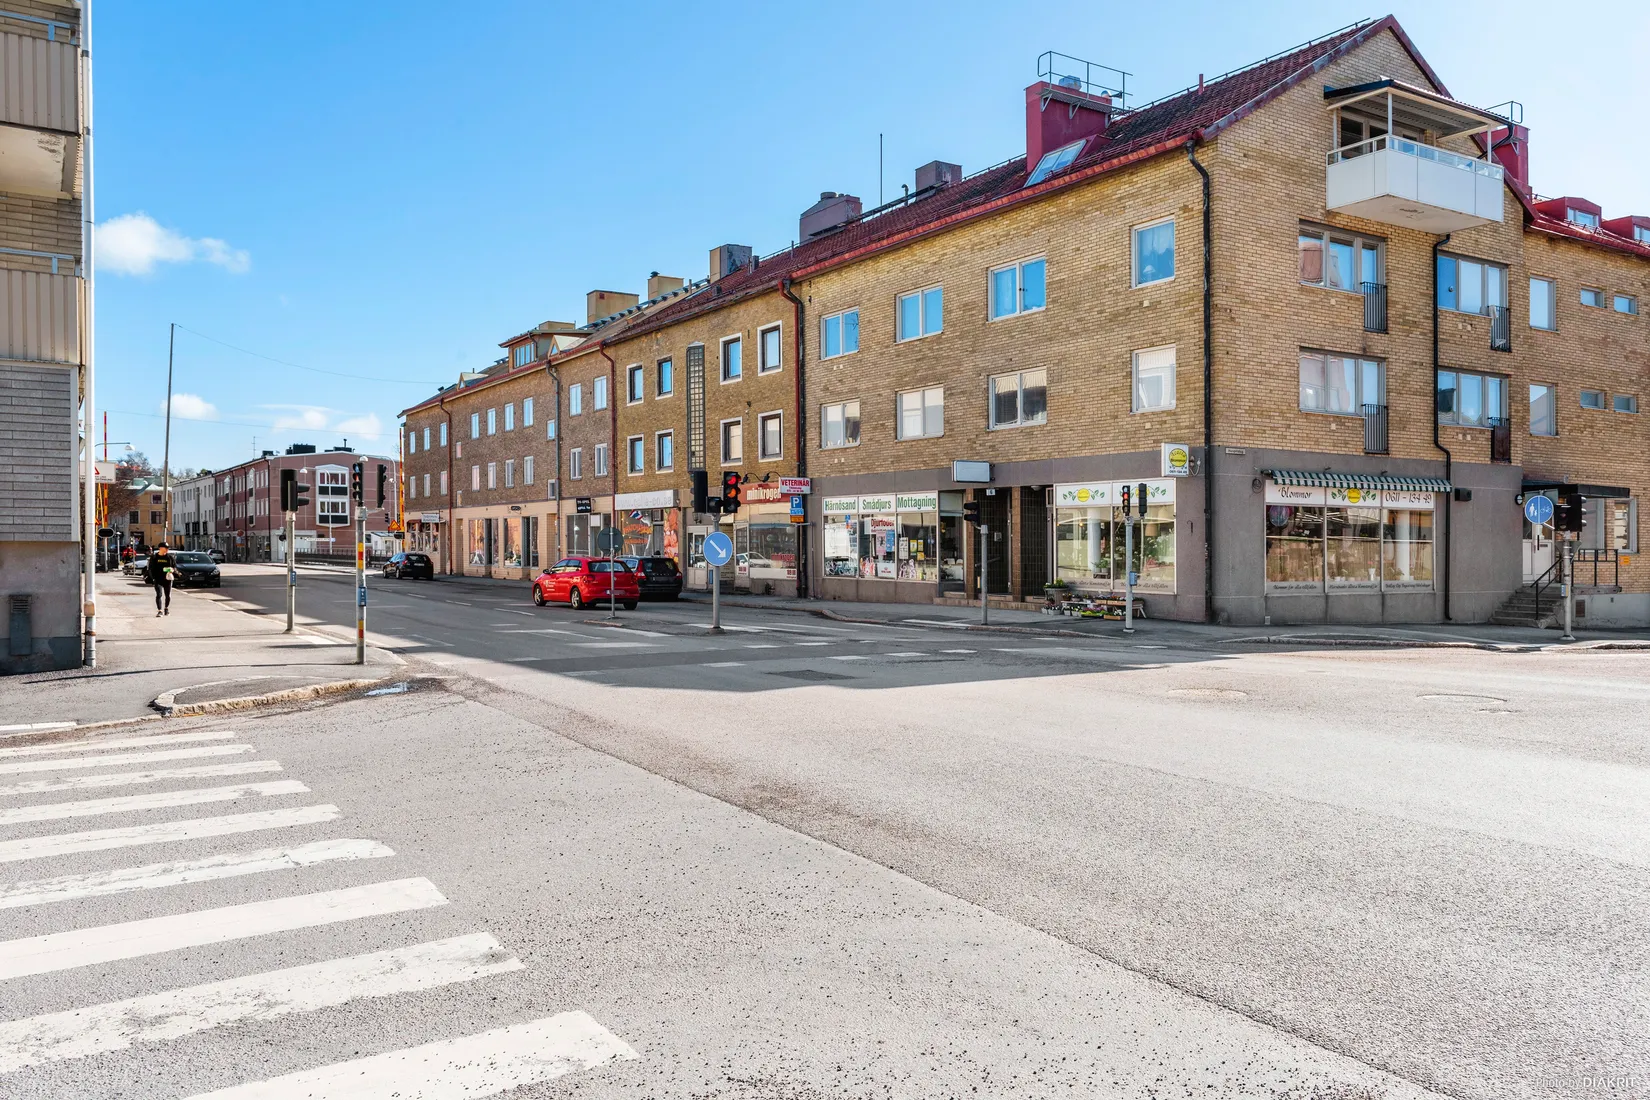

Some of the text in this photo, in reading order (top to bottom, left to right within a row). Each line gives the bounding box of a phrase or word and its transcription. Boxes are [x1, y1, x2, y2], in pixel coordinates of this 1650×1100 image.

[781, 478, 810, 487] VETERINÄR
[746, 487, 782, 501] minikrogen
[1278, 486, 1312, 499] Blommor
[1385, 491, 1400, 502] 0611
[1408, 492, 1421, 504] 134
[1423, 493, 1432, 504] 49
[792, 497, 800, 508] P
[825, 496, 937, 512] Härnösand Smådjurs Mottagning
